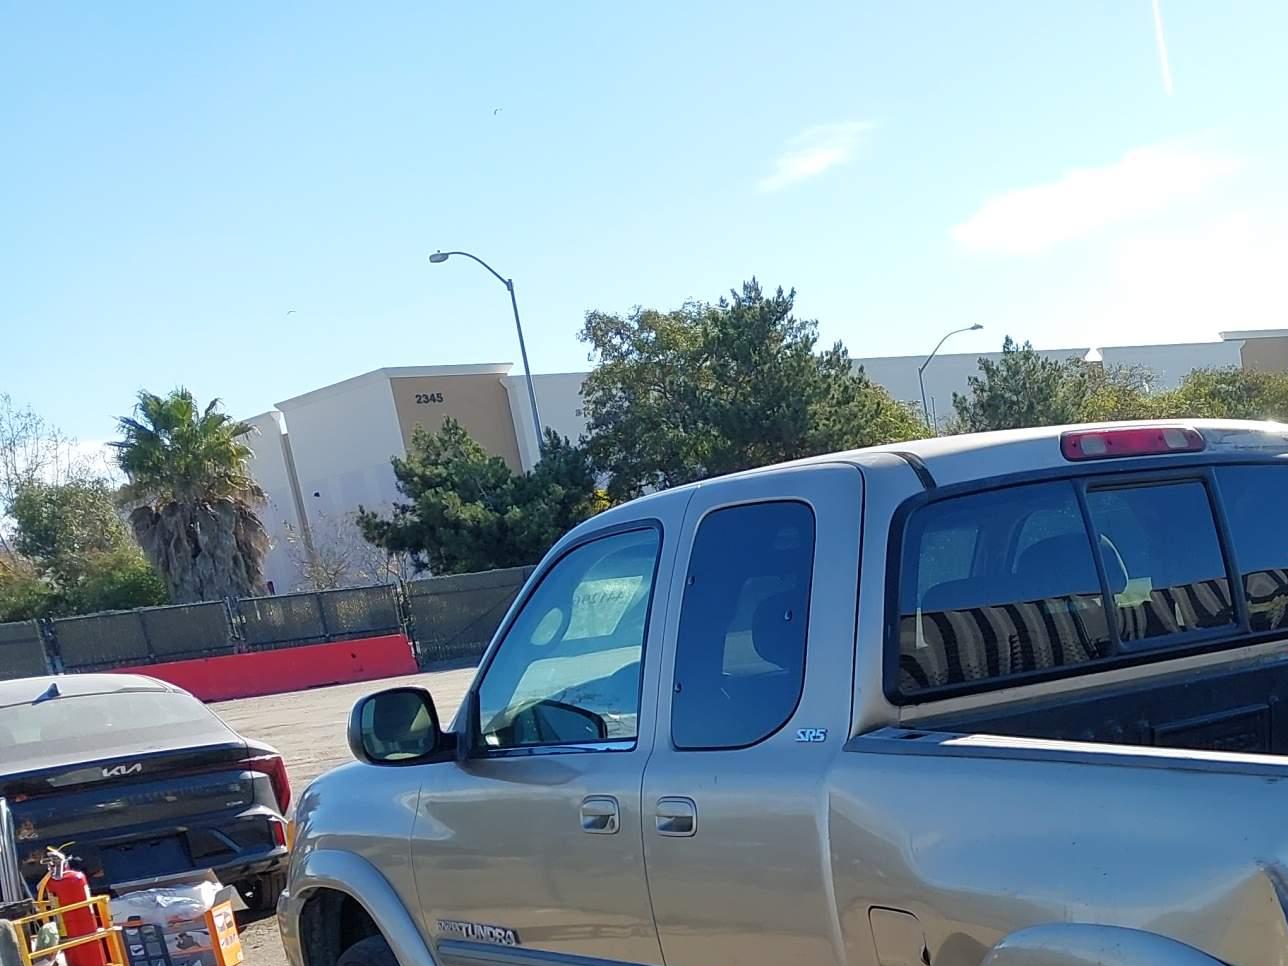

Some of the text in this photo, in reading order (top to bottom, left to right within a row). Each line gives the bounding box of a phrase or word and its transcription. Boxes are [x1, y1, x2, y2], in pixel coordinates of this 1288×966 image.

[415, 392, 443, 404] 2345
[795, 728, 827, 742] SR5
[102, 763, 142, 777] KIA
[459, 922, 516, 946] TUNDRA
